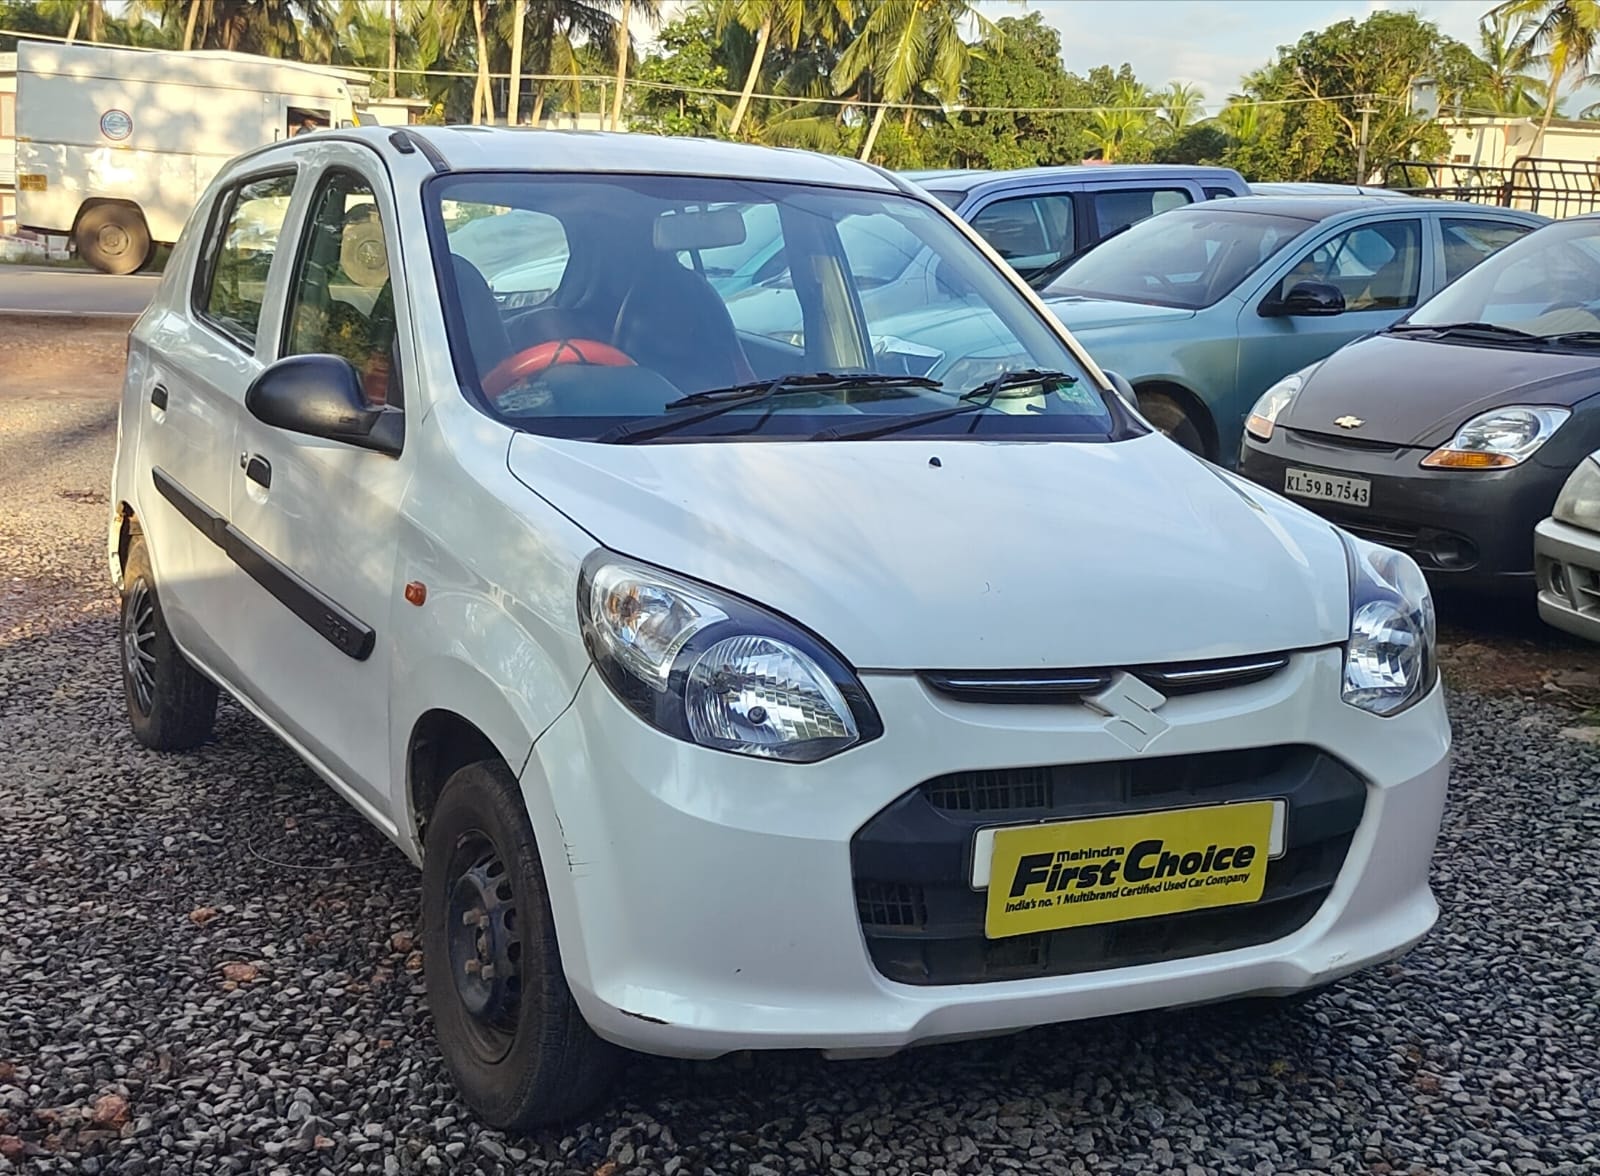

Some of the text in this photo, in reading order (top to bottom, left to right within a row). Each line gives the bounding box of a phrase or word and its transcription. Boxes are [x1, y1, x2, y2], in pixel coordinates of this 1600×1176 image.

[1009, 840, 1256, 897] First Choice
[1005, 873, 1249, 913] India's no. 1 Multibrand Certified Used Car Company
